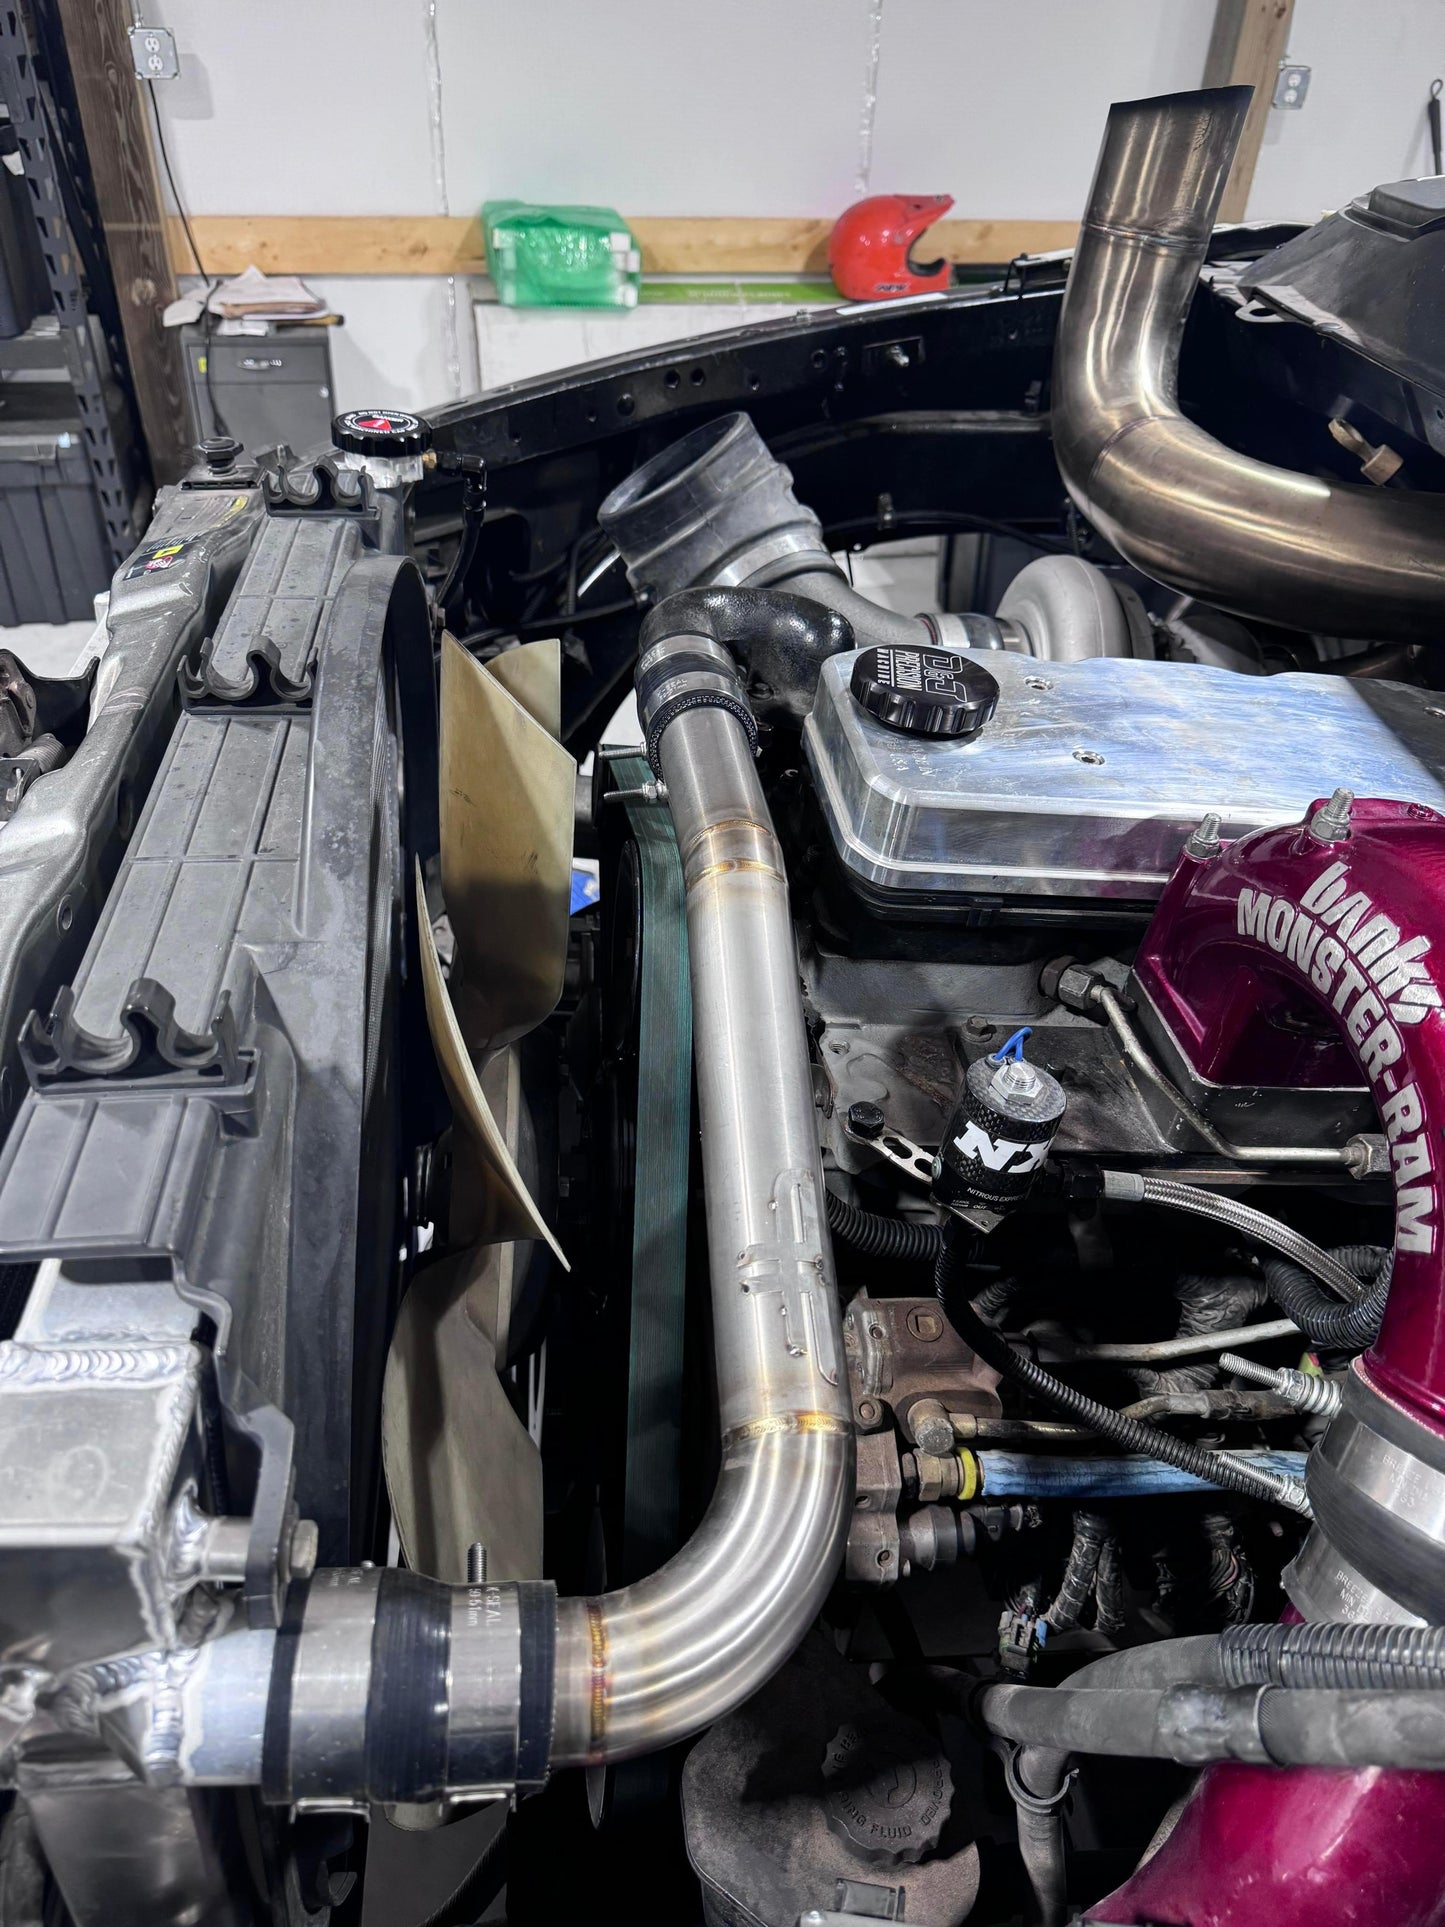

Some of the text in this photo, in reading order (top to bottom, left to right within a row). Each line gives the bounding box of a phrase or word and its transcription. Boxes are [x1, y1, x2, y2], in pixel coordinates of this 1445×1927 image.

[876, 648, 891, 685] MACHINE
[895, 649, 922, 691] PRECISION
[923, 654, 968, 702] D&J
[1237, 888, 1433, 1255] MONSTER-RAM
[967, 1187, 999, 1202] NITROUS
[870, 1823, 912, 1839] FLUID
